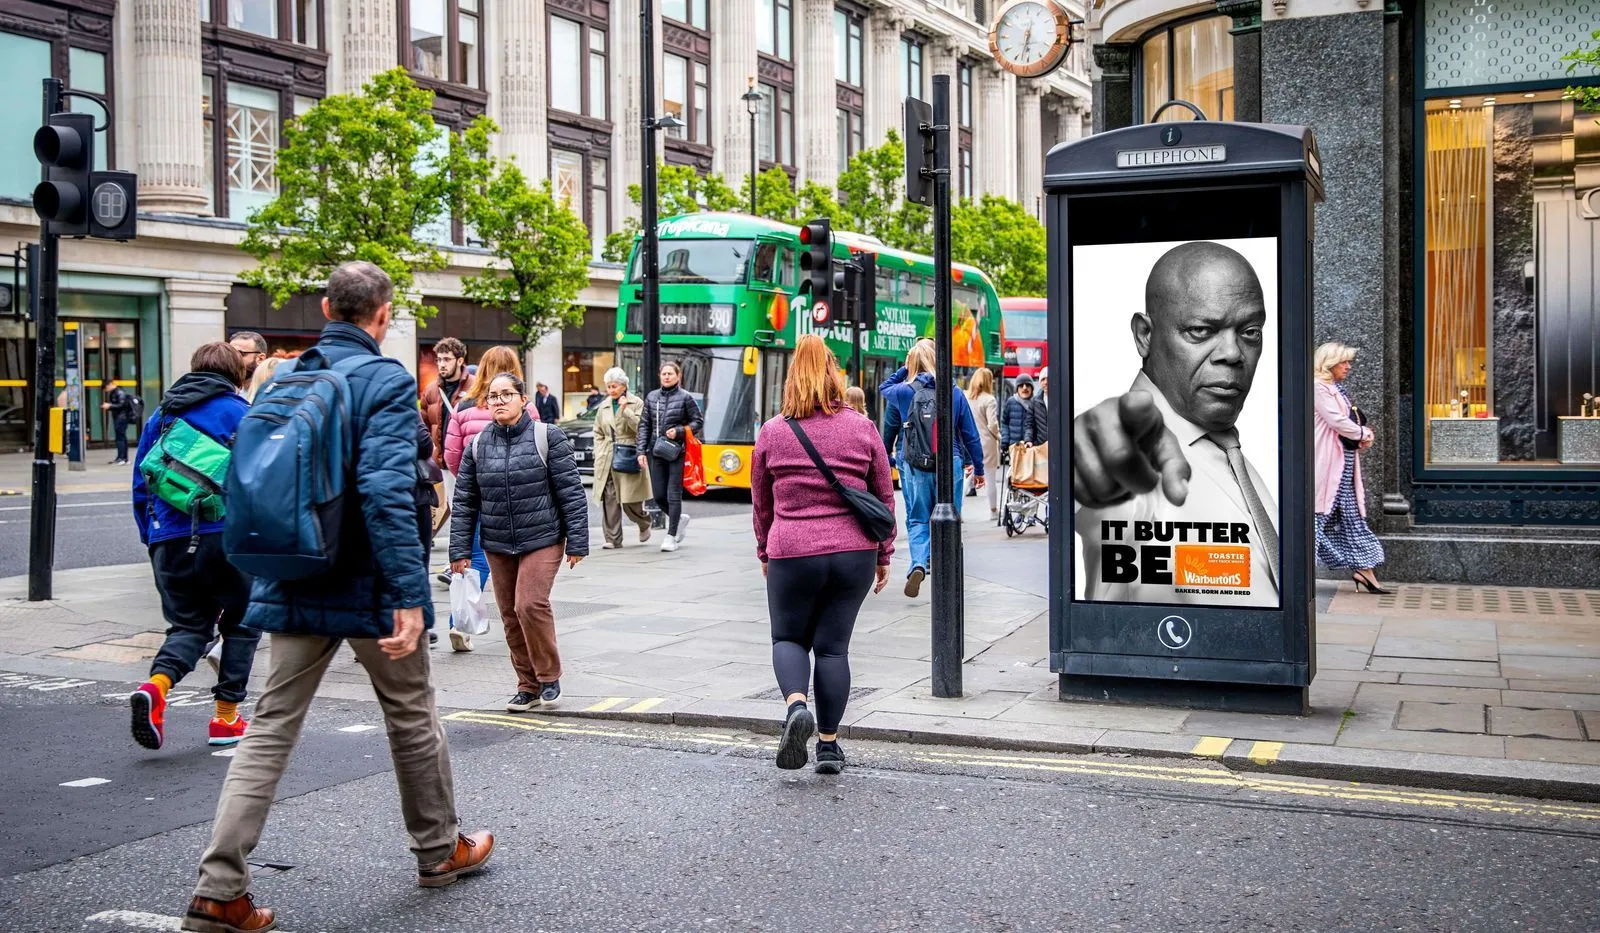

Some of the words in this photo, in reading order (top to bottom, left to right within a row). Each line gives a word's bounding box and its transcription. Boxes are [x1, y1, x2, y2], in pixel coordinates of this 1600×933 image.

[1124, 147, 1219, 166] TELEPHONE
[707, 308, 731, 329] 390
[876, 319, 917, 338] ORANGES
[1026, 349, 1041, 361] 94
[1101, 520, 1128, 541] IT
[1134, 521, 1251, 544] BUTTER
[1101, 544, 1173, 585] BE
[1208, 552, 1245, 560] TOASTIE
[1183, 569, 1241, 585] Warburtons
